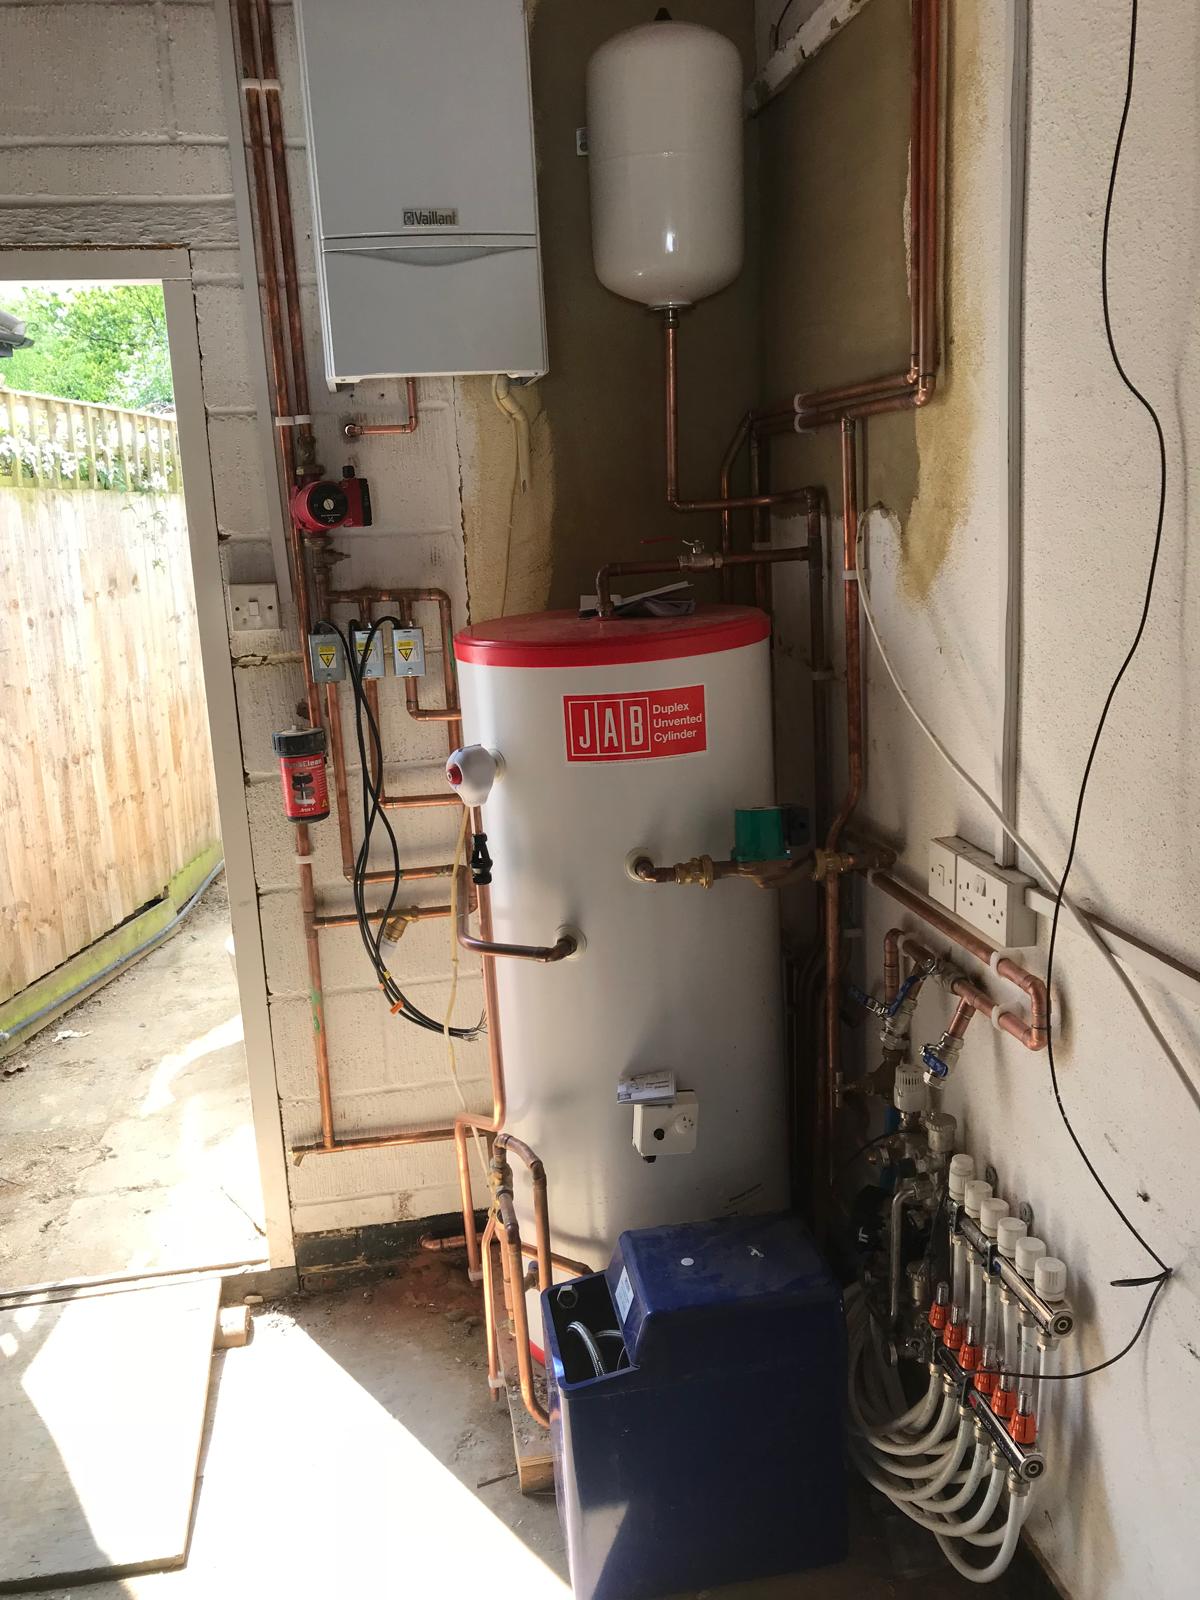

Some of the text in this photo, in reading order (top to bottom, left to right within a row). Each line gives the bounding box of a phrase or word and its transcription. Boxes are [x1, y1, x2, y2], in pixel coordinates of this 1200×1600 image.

[415, 211, 457, 225] Vaillant
[652, 702, 689, 716] Duplex
[579, 706, 644, 749] JAB
[653, 713, 703, 729] Unvented
[653, 729, 697, 743] Cylinder
